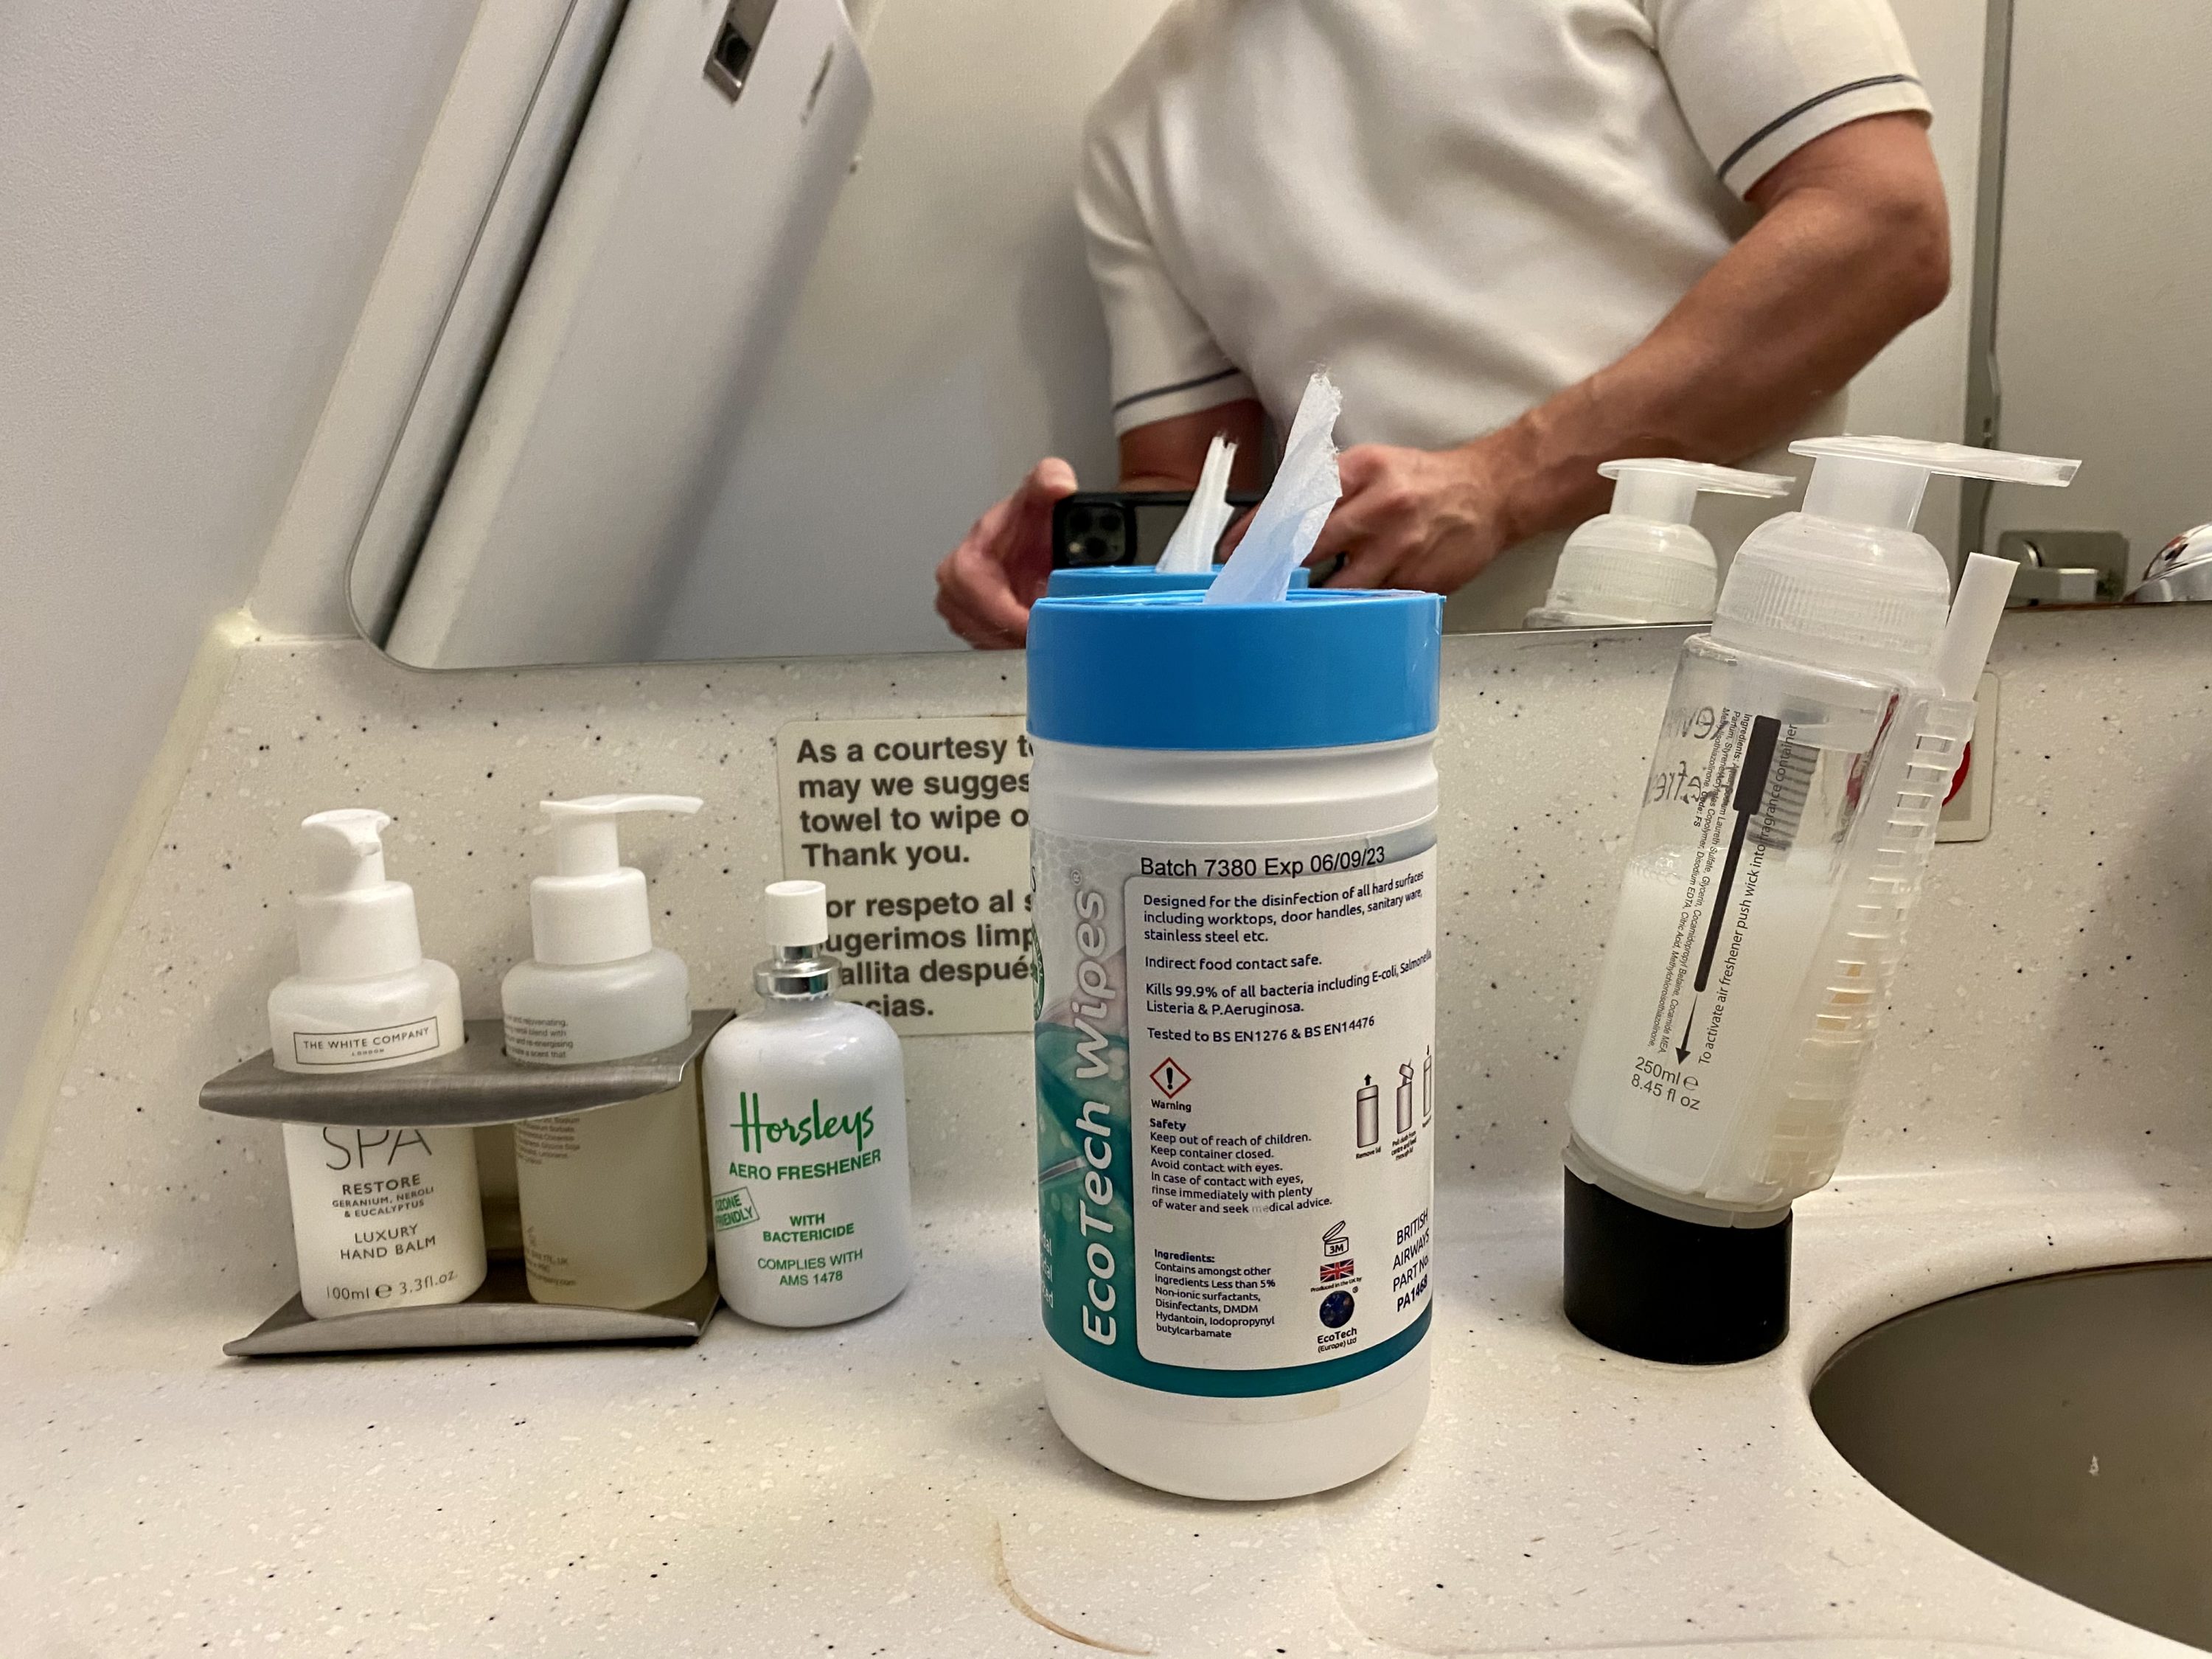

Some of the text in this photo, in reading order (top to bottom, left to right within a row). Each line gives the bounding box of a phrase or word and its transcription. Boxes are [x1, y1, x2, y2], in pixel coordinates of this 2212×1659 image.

[1733, 714, 1752, 761] Ingredients:
[797, 736, 1007, 765] As a courtesy
[799, 773, 1029, 804] may we sugges
[800, 807, 881, 833] towel
[891, 807, 921, 830] to
[931, 805, 1001, 834] wipe
[801, 841, 970, 870] Thank you.
[1141, 846, 1385, 878] Batch 7380 Exp 06/09/23
[1144, 872, 1424, 909] Designed for the disinfection of all hard surfaces
[1698, 723, 1798, 1064] To activate air freshener push wick into fragrance container
[827, 899, 855, 918] or
[866, 891, 979, 921] respeto
[989, 889, 1013, 913] al
[1144, 911, 1204, 927] including
[1208, 913, 1276, 926] worktops,
[1281, 911, 1312, 922] door
[1317, 905, 1365, 919] handles,
[1367, 894, 1403, 912] sanitary
[823, 924, 1032, 957] ugerimos limp
[1144, 928, 1268, 942] stainless steel etc.
[841, 956, 1037, 986] allita despué
[1145, 954, 1321, 970] Indirect food contact safe.
[1146, 983, 1172, 996] Kills
[1175, 986, 1217, 998] 99.9%
[1222, 985, 1237, 998] of
[1240, 984, 1256, 998] all
[1260, 982, 1314, 996] bacteria
[1318, 975, 1369, 992] including
[1372, 964, 1399, 982] E-coli,
[1147, 1000, 1304, 1018] Listeria & P.Aeruginosa.
[303, 1027, 429, 1049] THE WHITE COMPANY
[1147, 1015, 1374, 1042] Tested to BS EN1276 & BS EN14476
[1635, 1057, 1680, 1085] 250ml
[1632, 1074, 1700, 1110] 8.45 fl oz
[1151, 1099, 1192, 1113] Warning
[730, 1092, 874, 1153] Horsleys
[1150, 1118, 1186, 1132] Safety
[323, 1127, 432, 1170] SPA
[1150, 1132, 1311, 1146] Keep out of reach of children.
[1150, 1145, 1274, 1159] Keep container closed.
[729, 1149, 881, 1180] AERO FRESHENER
[1151, 1158, 1283, 1174] Avoid contact with eyes.
[342, 1174, 421, 1195] RESTORE
[1151, 1172, 1304, 1186] In case of contact with eyes,
[332, 1186, 434, 1208] GERANIUM, NEROLI
[1152, 1185, 1312, 1202] rinse immediately with plenty
[355, 1199, 425, 1217] EUCALYPTUS
[1152, 1197, 1332, 1214] of water and seek medical advice.
[790, 1213, 825, 1226] WITH
[1076, 1100, 1116, 1345] EcoTech
[1397, 1208, 1427, 1245] BRITISH
[355, 1223, 418, 1243] LUXURY
[762, 1223, 855, 1242] BACTERICIDE
[340, 1235, 436, 1260] HAND BALM
[1155, 1249, 1215, 1263] Ingredients:
[1329, 1244, 1343, 1254] 3M
[1393, 1228, 1429, 1270] AIRWAYS
[757, 1249, 863, 1270] COMPLIES WITH
[1155, 1262, 1271, 1278] Contains amongst other
[779, 1270, 843, 1286] AMS 1478
[1155, 1273, 1276, 1289] Ingredients Less than 5%
[1394, 1262, 1418, 1292] PART
[327, 1286, 369, 1300] 100ml
[1155, 1287, 1261, 1301] Non-ionic surfactants,
[1397, 1274, 1427, 1312] PA1468
[1156, 1298, 1258, 1314] Disinfectants, DMDM
[1156, 1311, 1275, 1327] Hydantoin, Iodopropynyl
[1156, 1323, 1232, 1338] butylcarbamate
[1318, 1327, 1357, 1343] EcoTech
[1318, 1340, 1346, 1353] (Europe)
